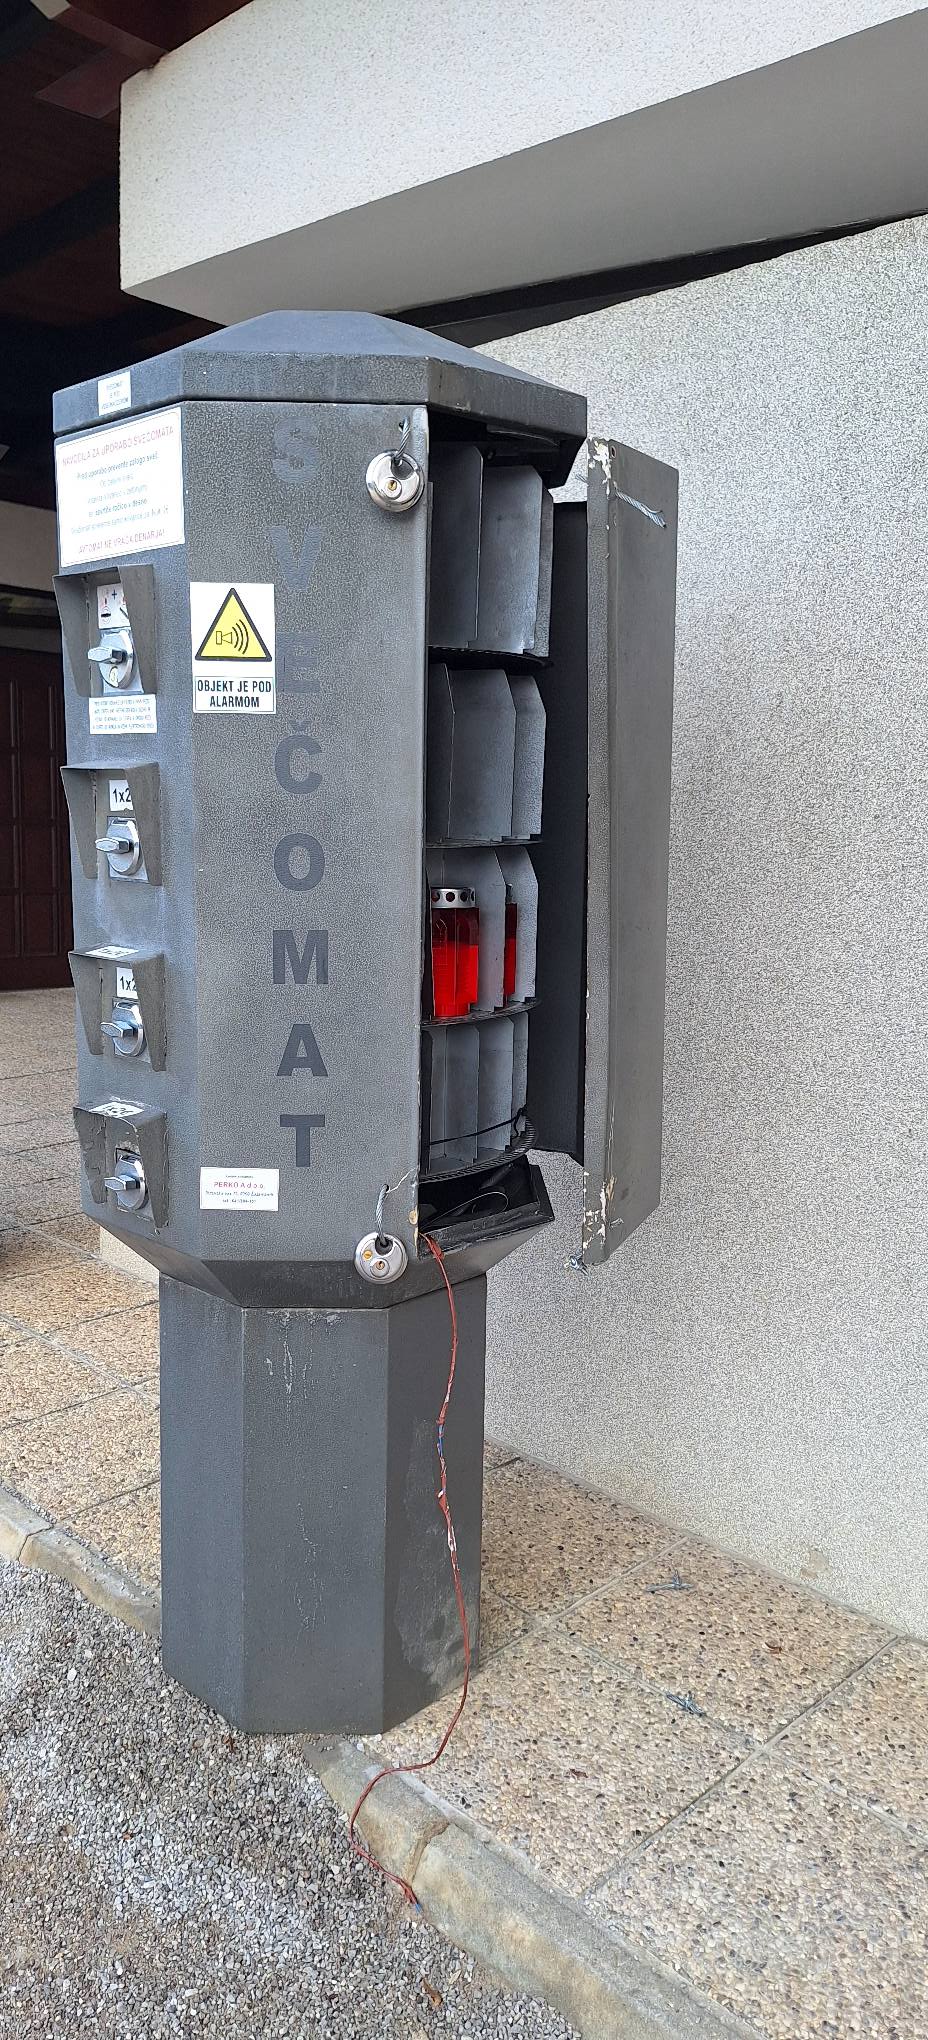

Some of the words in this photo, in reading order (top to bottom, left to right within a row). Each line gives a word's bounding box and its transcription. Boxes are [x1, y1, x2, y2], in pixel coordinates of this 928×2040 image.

[197, 680, 234, 692] OBJEKT
[237, 681, 249, 692] JE
[252, 681, 272, 692] POD
[209, 696, 260, 707] ALARMOM
[272, 416, 328, 1168] SVEČOMAT
